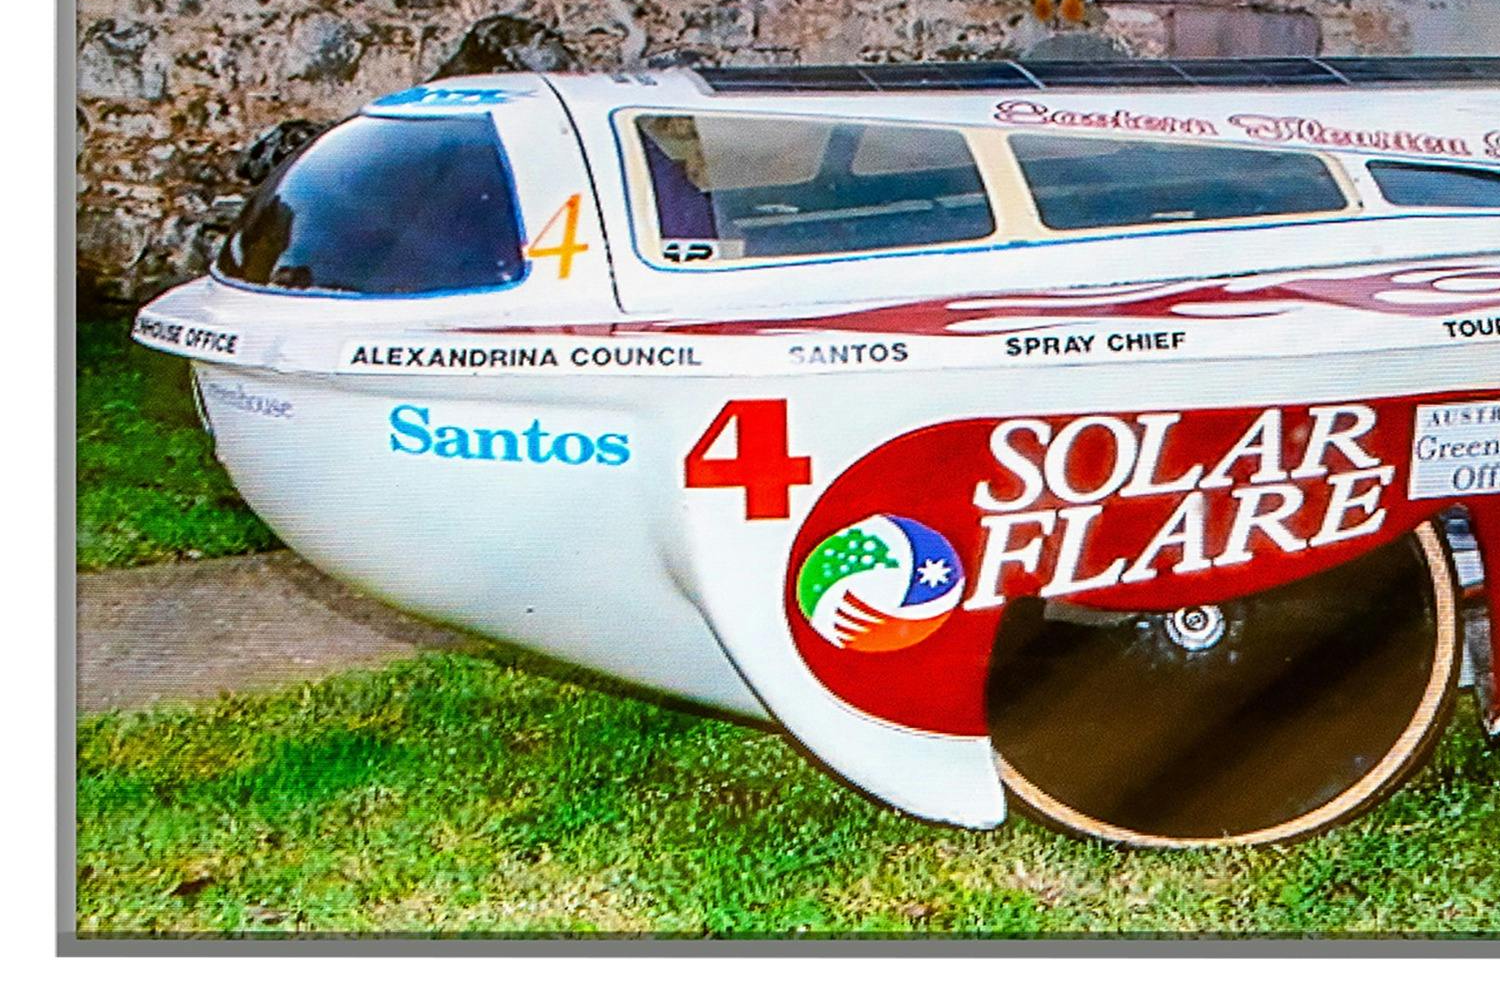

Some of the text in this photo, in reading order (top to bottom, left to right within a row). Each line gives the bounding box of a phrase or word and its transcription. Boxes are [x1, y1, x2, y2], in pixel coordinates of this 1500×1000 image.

[528, 194, 588, 278] 4
[351, 346, 702, 367] ALEXANDRINA COUNCIL
[789, 343, 909, 365] SANTOS
[1006, 332, 1186, 356] SPRAY CHIEF
[388, 404, 630, 466] Santos
[684, 399, 812, 521] 4
[973, 405, 1382, 512] SOLAR
[962, 465, 1394, 612] FLARE
